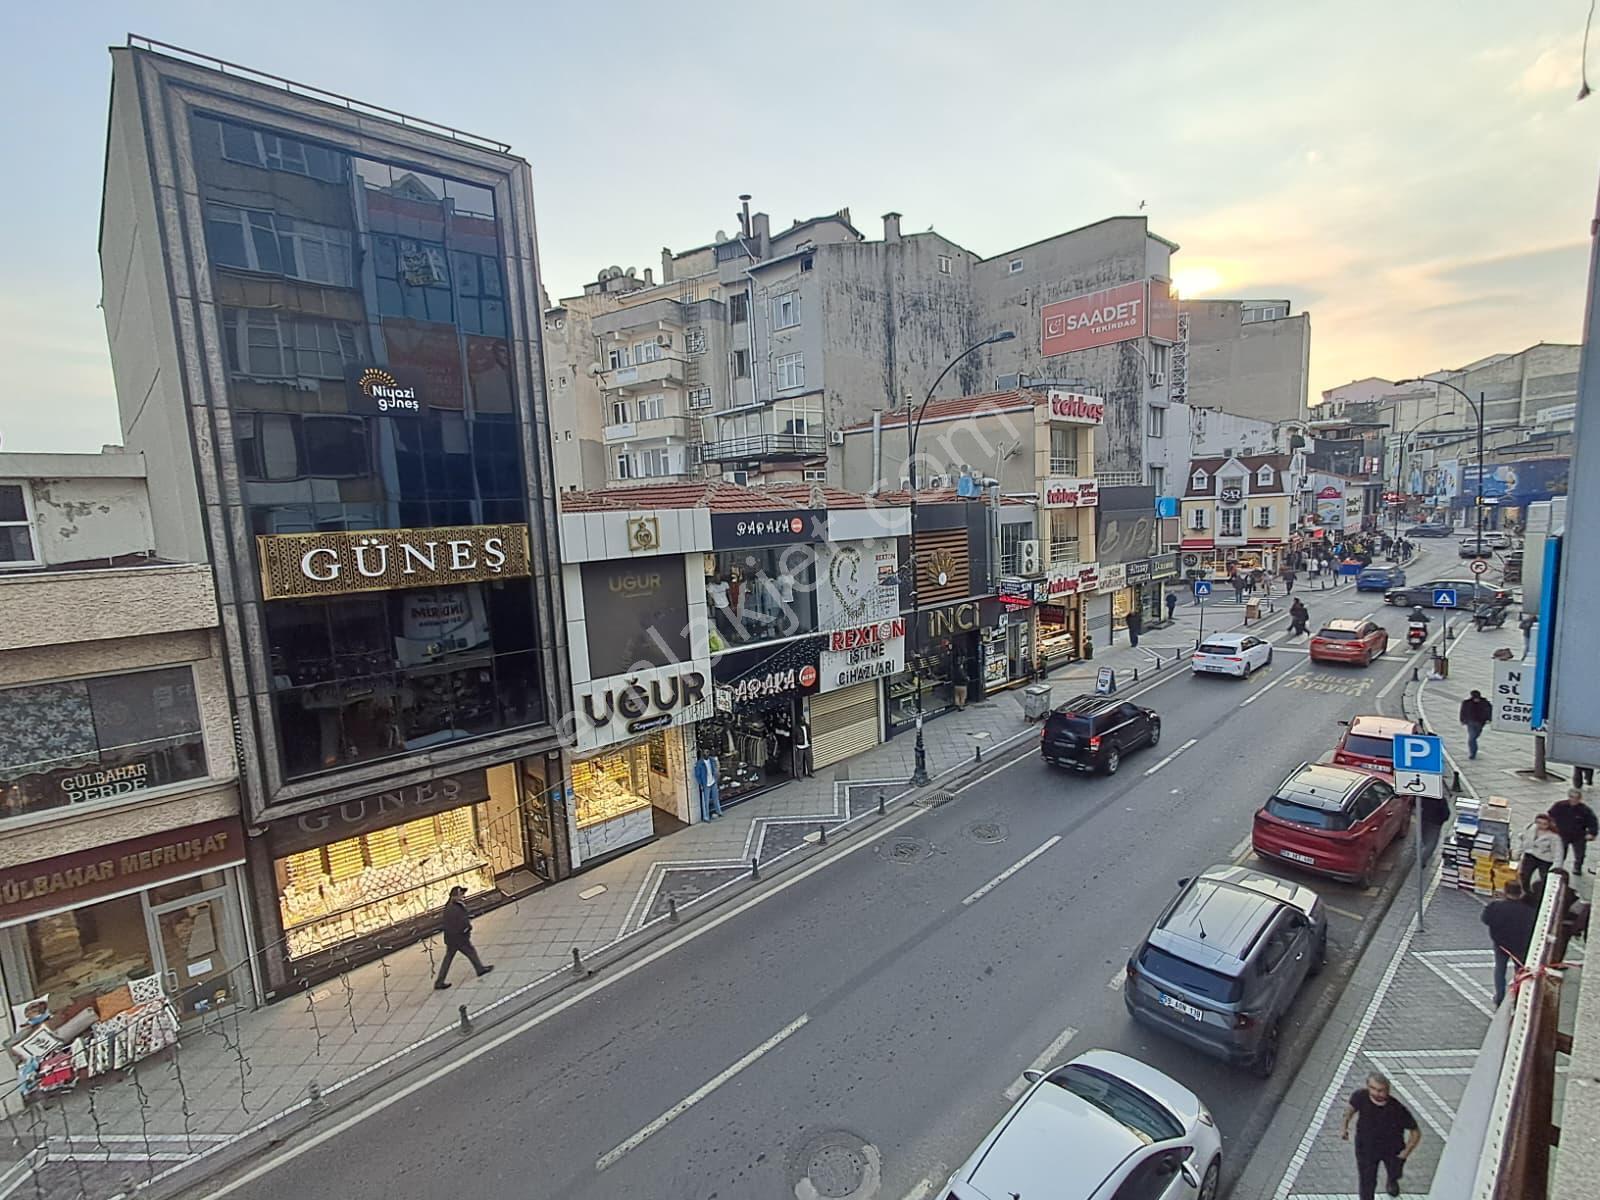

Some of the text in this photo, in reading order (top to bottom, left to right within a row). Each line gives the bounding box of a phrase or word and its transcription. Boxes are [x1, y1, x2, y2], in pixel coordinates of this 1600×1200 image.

[1067, 299, 1141, 331] SAADET
[372, 385, 415, 399] Niyazi
[378, 397, 419, 412] güneş
[1052, 394, 1104, 423] tekbaş
[736, 519, 790, 537] BARAKA
[301, 537, 507, 583] GÜNEŞ
[832, 619, 905, 651] REXTON
[849, 643, 885, 664] İŞİTME
[734, 668, 795, 702] ARAKA
[838, 660, 895, 685] CİHAZLARI
[582, 672, 706, 728] UĞUR
[1404, 739, 1431, 766] P
[61, 763, 148, 791] GÜLBAHAR
[67, 777, 148, 804] PERDE
[0, 832, 228, 905] ÜLBAHAR MEFRUŞAT
